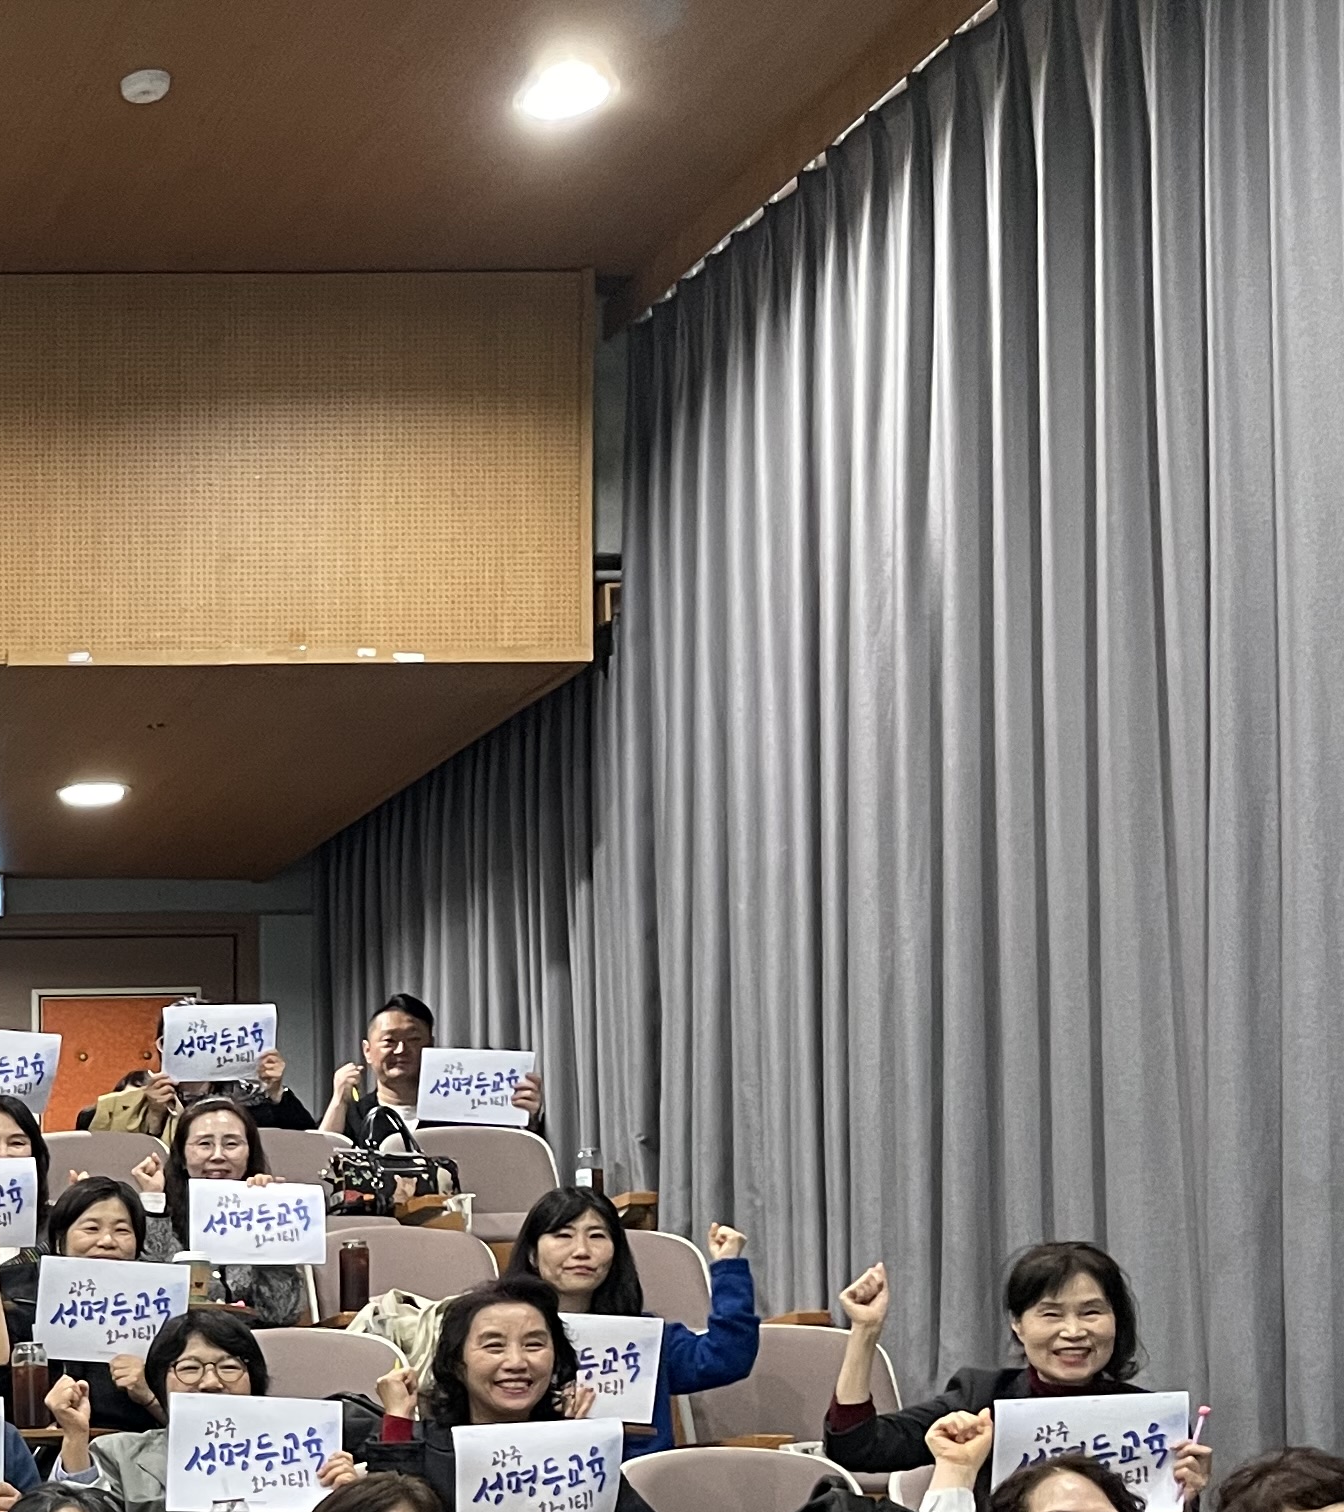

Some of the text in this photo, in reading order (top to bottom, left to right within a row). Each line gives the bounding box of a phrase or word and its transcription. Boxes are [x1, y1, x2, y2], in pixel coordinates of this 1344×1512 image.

[174, 1022, 263, 1058] 성평등교육
[203, 1199, 310, 1235] 성평등교육
[69, 1279, 96, 1295] 광주
[50, 1288, 170, 1327] 성평등교육
[578, 1342, 640, 1382] 등교육
[205, 1419, 237, 1437] 광주
[1034, 1422, 1069, 1443] 광주
[185, 1427, 324, 1475] 성평등교육
[492, 1446, 522, 1466] 광주
[473, 1446, 604, 1505] 성평등교육
